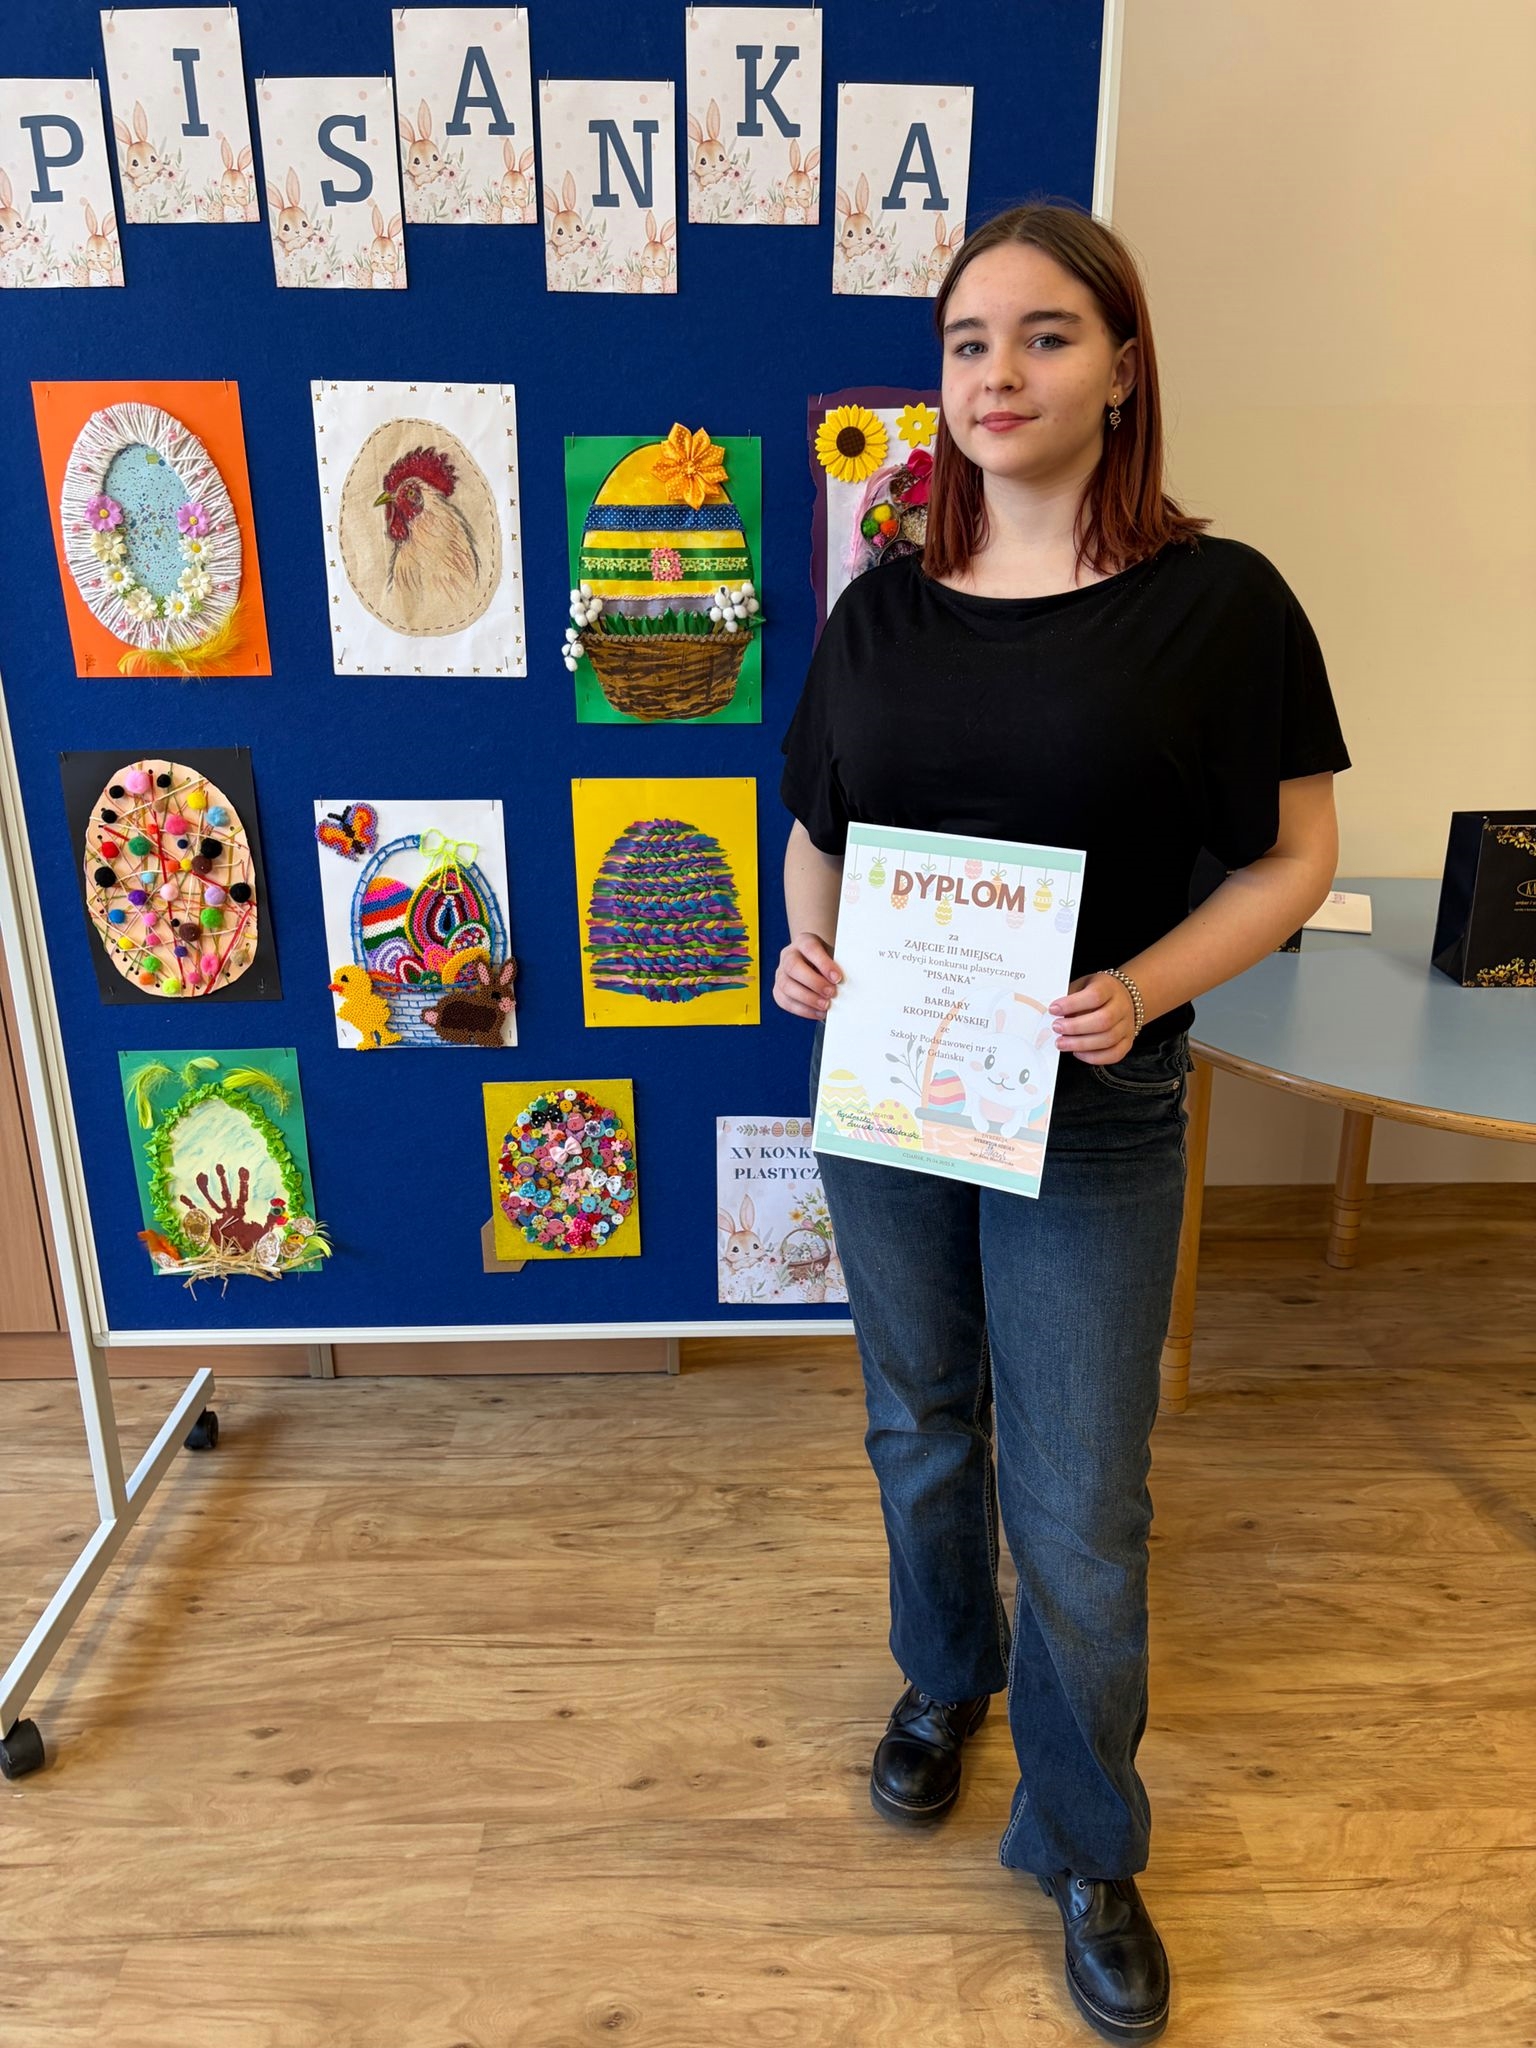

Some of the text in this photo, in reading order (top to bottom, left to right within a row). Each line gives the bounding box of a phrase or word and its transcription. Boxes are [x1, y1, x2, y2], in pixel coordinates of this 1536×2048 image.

[892, 869, 1026, 913] DYPLOM
[948, 934, 959, 942] za
[904, 939, 1004, 962] ZAJĘCIE III MIEJSCA
[887, 950, 901, 959] XV
[902, 953, 927, 966] edycji
[928, 956, 969, 971] konkursu
[970, 961, 1026, 980] plastycznego
[941, 986, 956, 996] dla
[924, 996, 971, 1011] BARBARY
[903, 1005, 990, 1029] KROPIDŁOWSKIEJ
[889, 1029, 998, 1055] Szkoły Podstawowej nr 47
[730, 1146, 818, 1160] XV KONK
